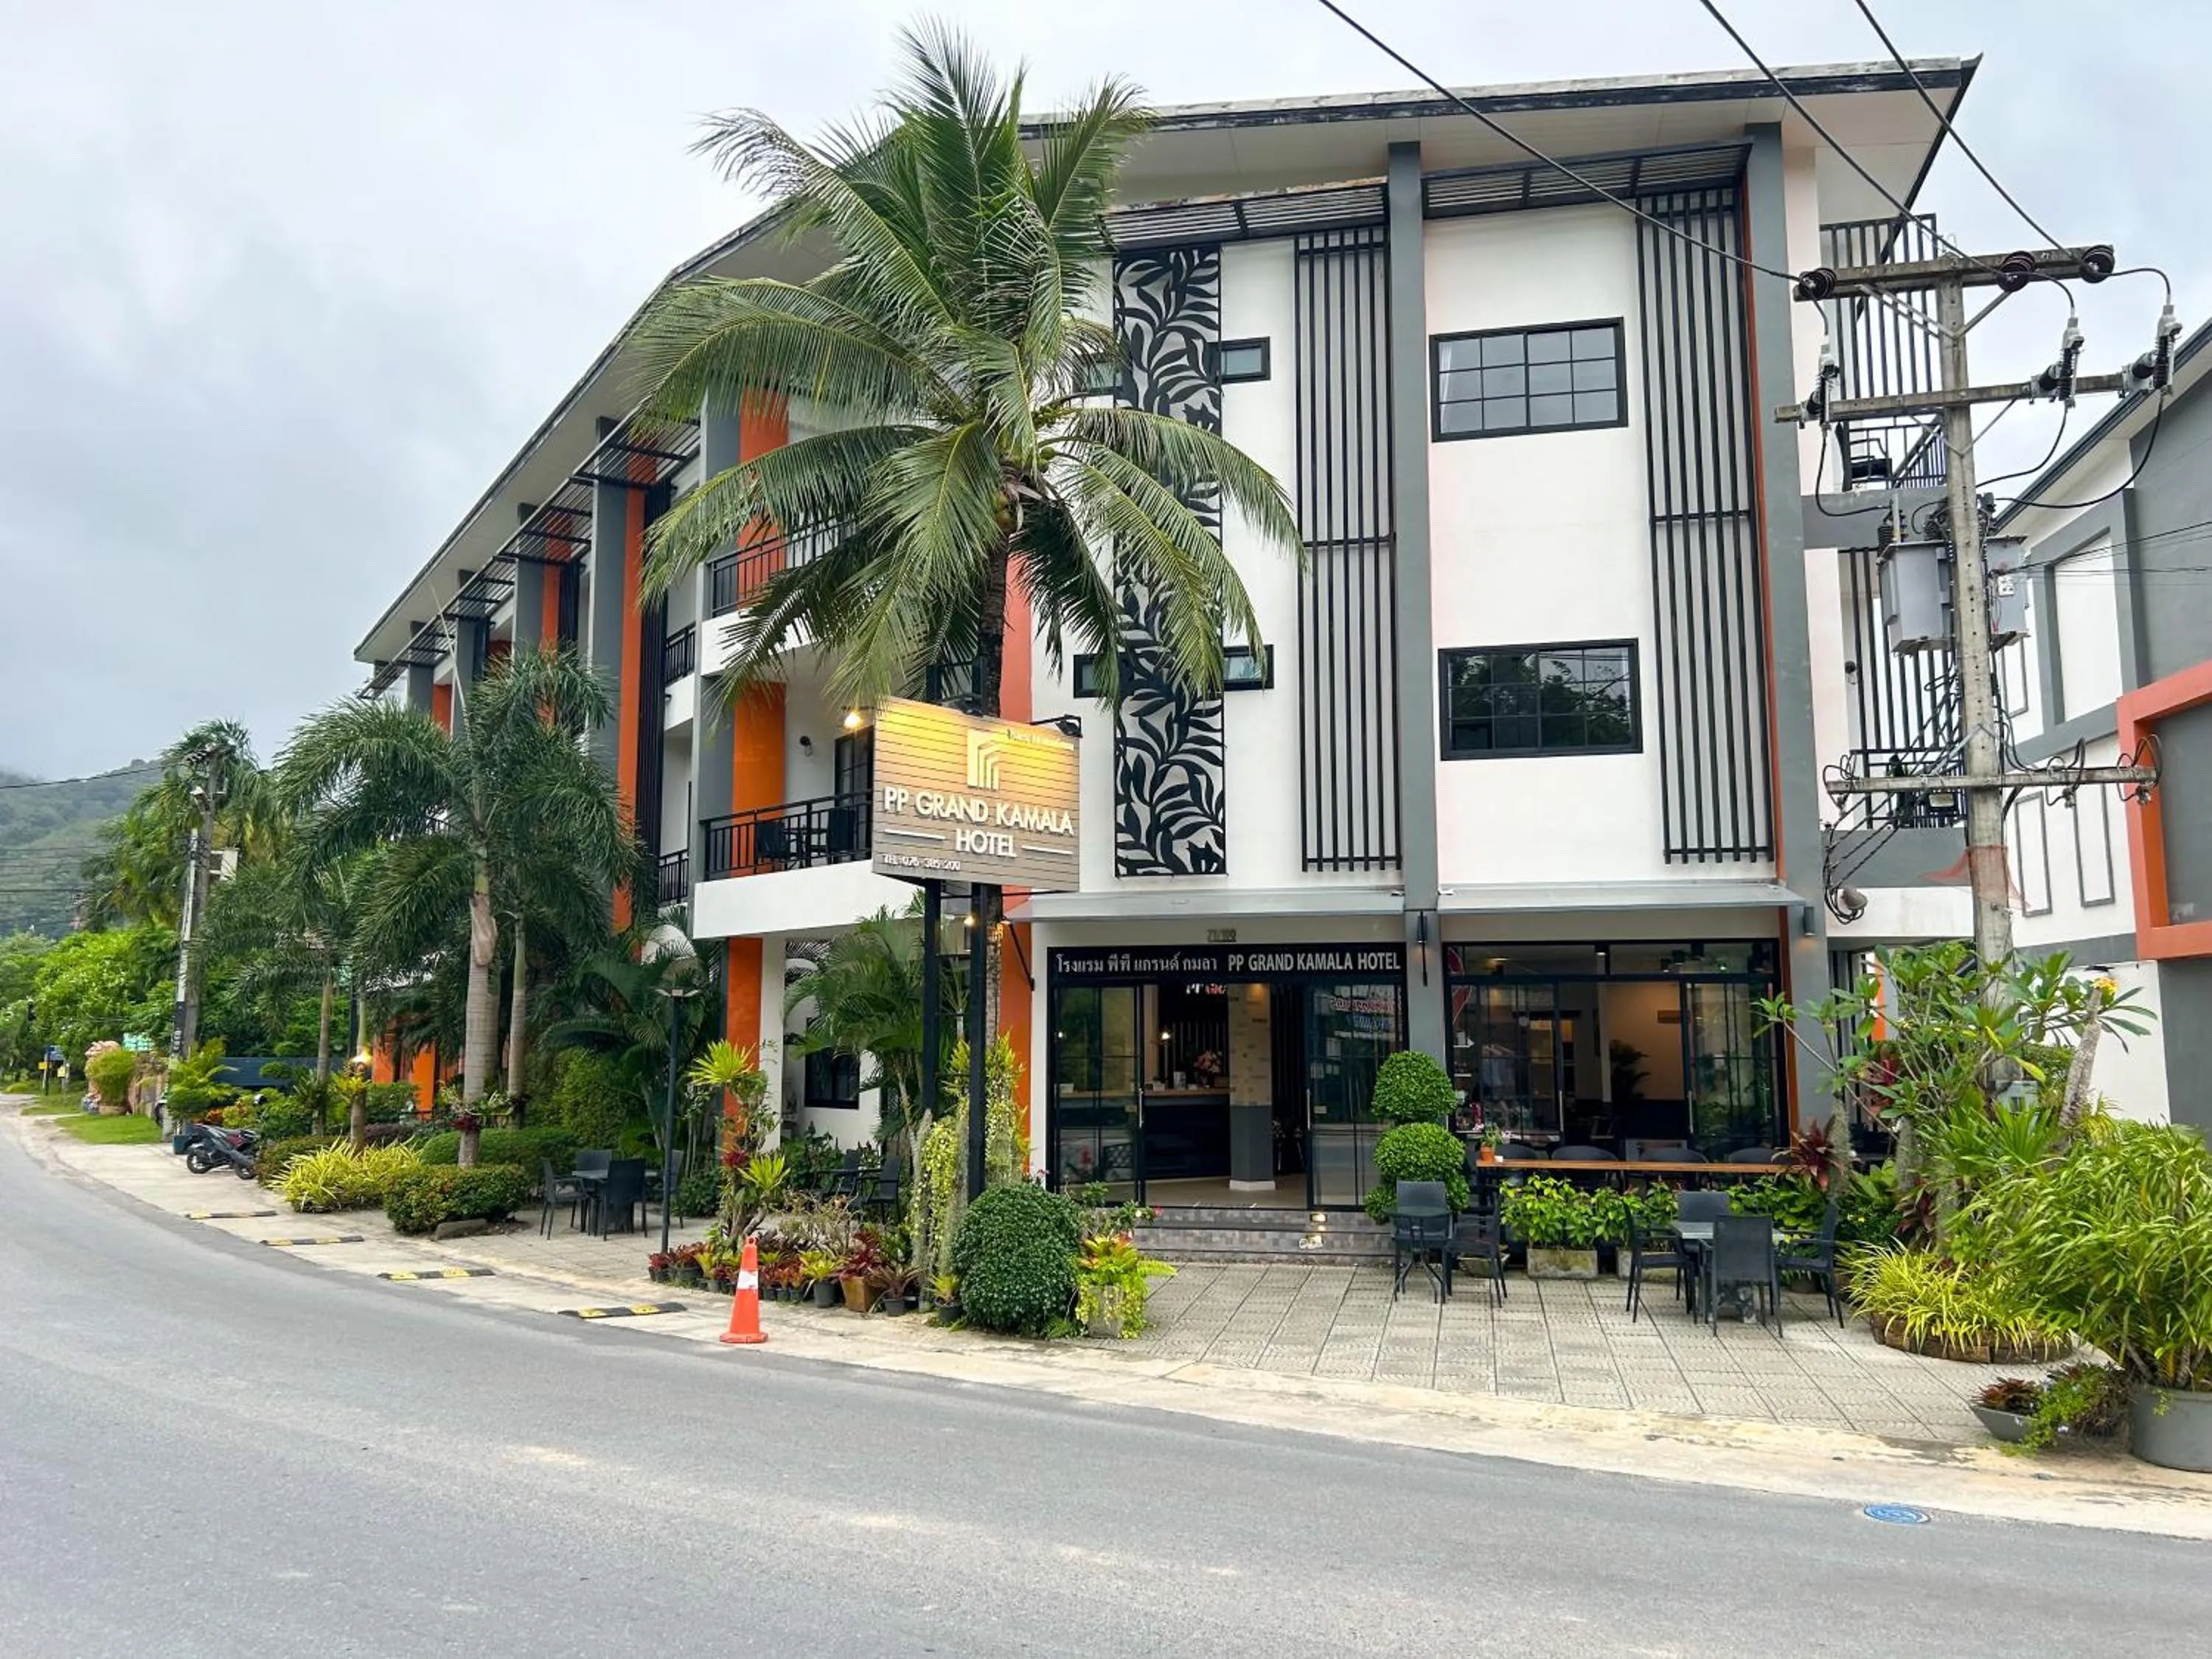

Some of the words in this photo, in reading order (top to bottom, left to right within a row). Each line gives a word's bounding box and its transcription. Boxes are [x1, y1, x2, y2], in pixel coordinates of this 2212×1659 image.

[884, 786, 909, 813] PP
[915, 791, 989, 824] GRAND
[995, 801, 1074, 836] KAMALA
[955, 828, 1018, 858] HOTEL
[1055, 953, 1105, 973] โรงแรม
[1133, 951, 1181, 972] แกรนด์
[1182, 957, 1218, 972] กมลา
[1228, 953, 1245, 972] PP
[1248, 953, 1294, 972] GRAND
[1297, 953, 1354, 971] KAMALA
[1357, 952, 1402, 970] HOTEL
